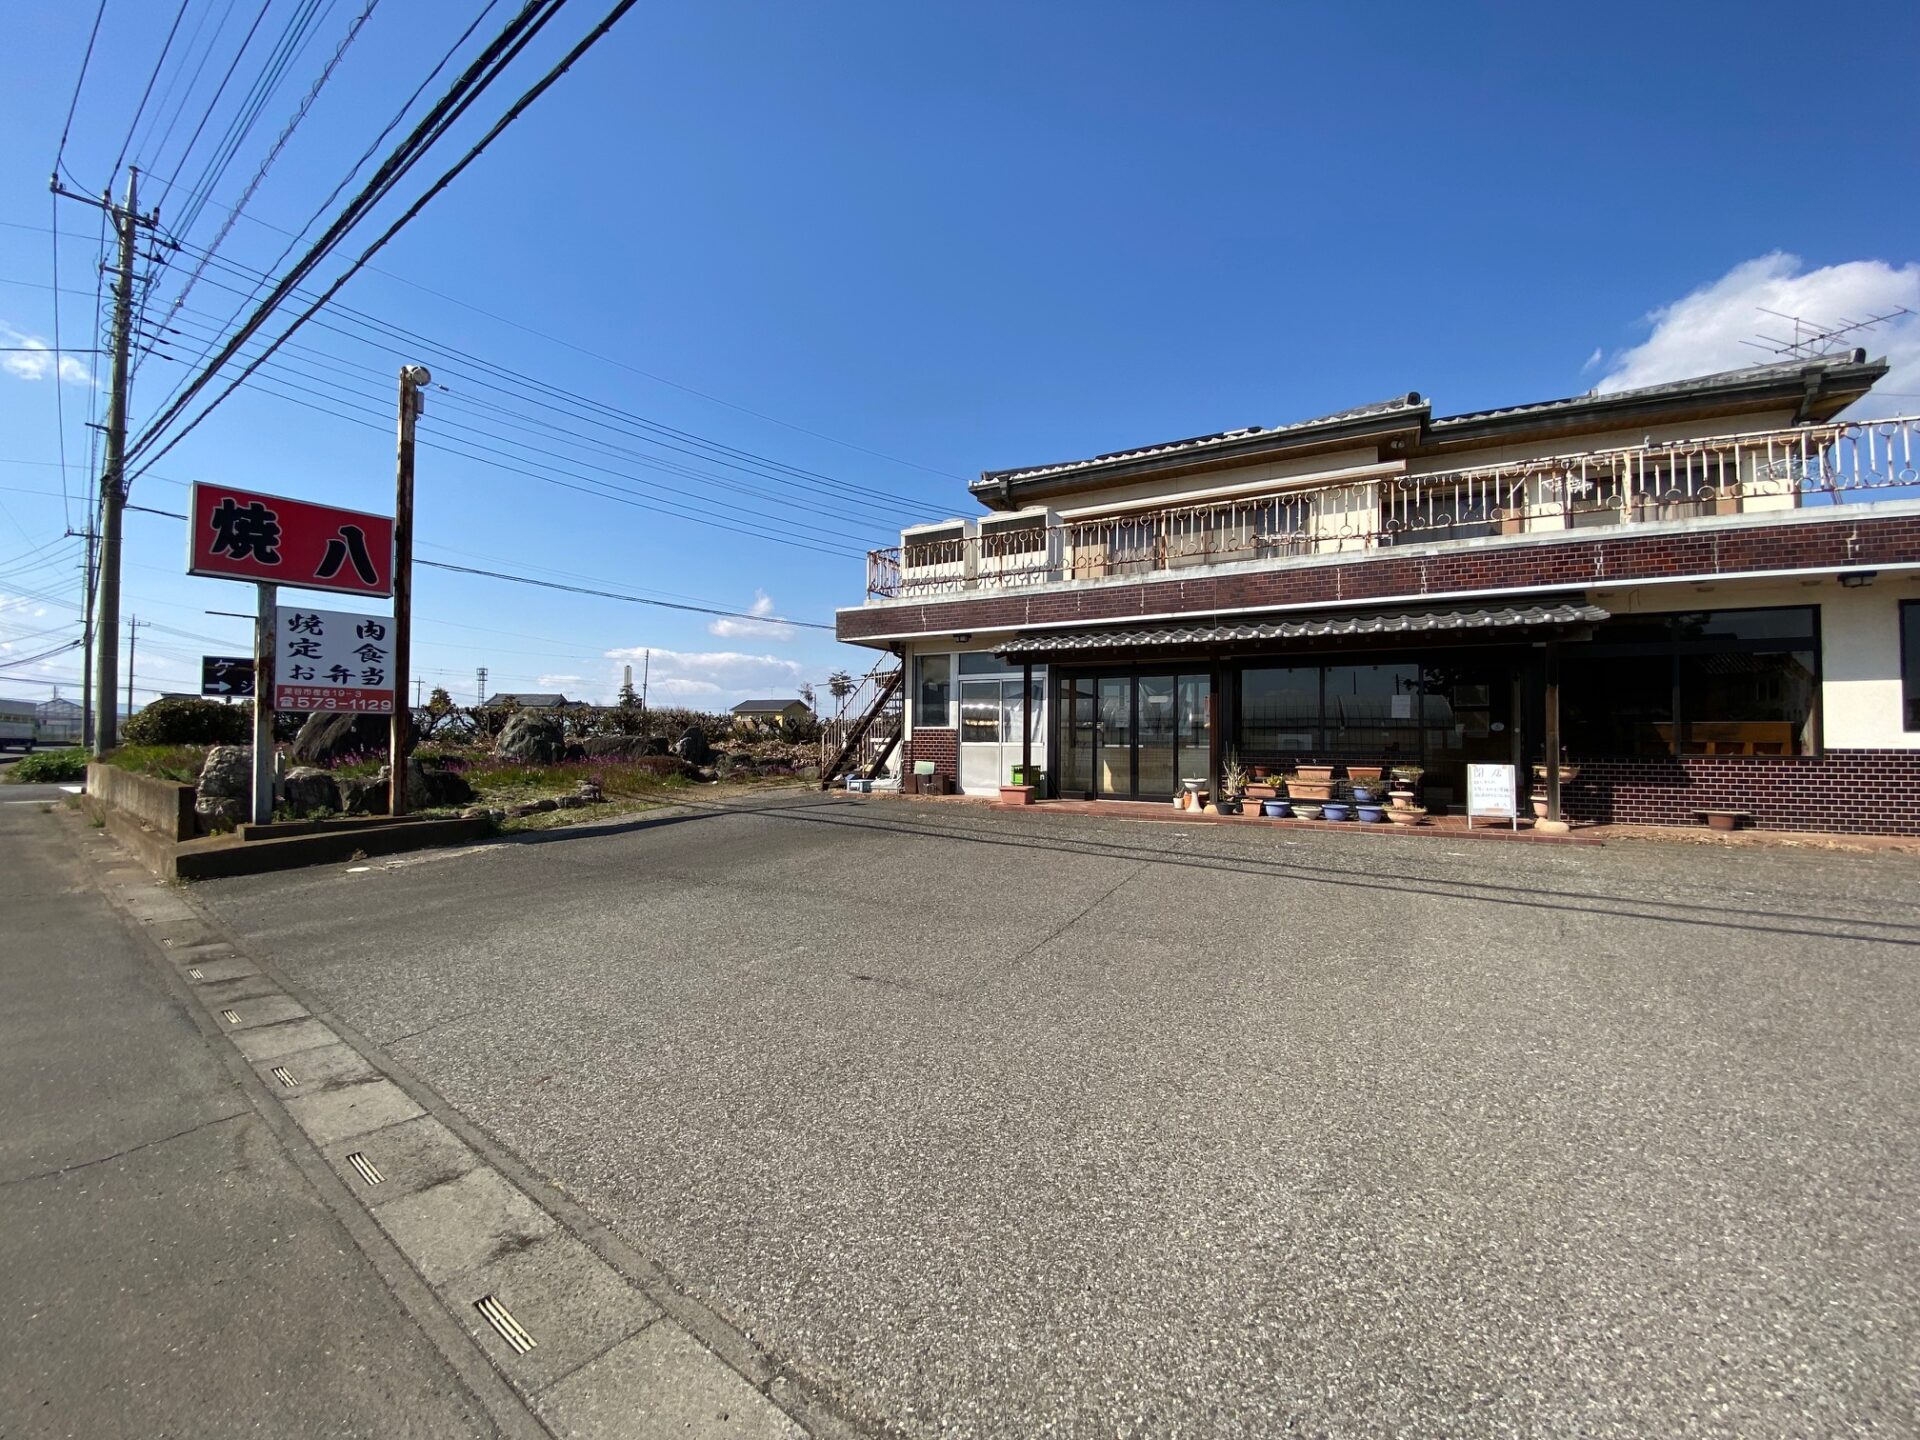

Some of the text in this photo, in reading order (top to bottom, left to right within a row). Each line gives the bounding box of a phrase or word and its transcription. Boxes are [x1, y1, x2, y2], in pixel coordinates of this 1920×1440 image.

[210, 498, 378, 585] 焼八
[287, 613, 386, 641] 焼肉
[288, 638, 388, 663] 定食
[289, 664, 385, 686] お弁当
[297, 696, 392, 711] 573-1129
